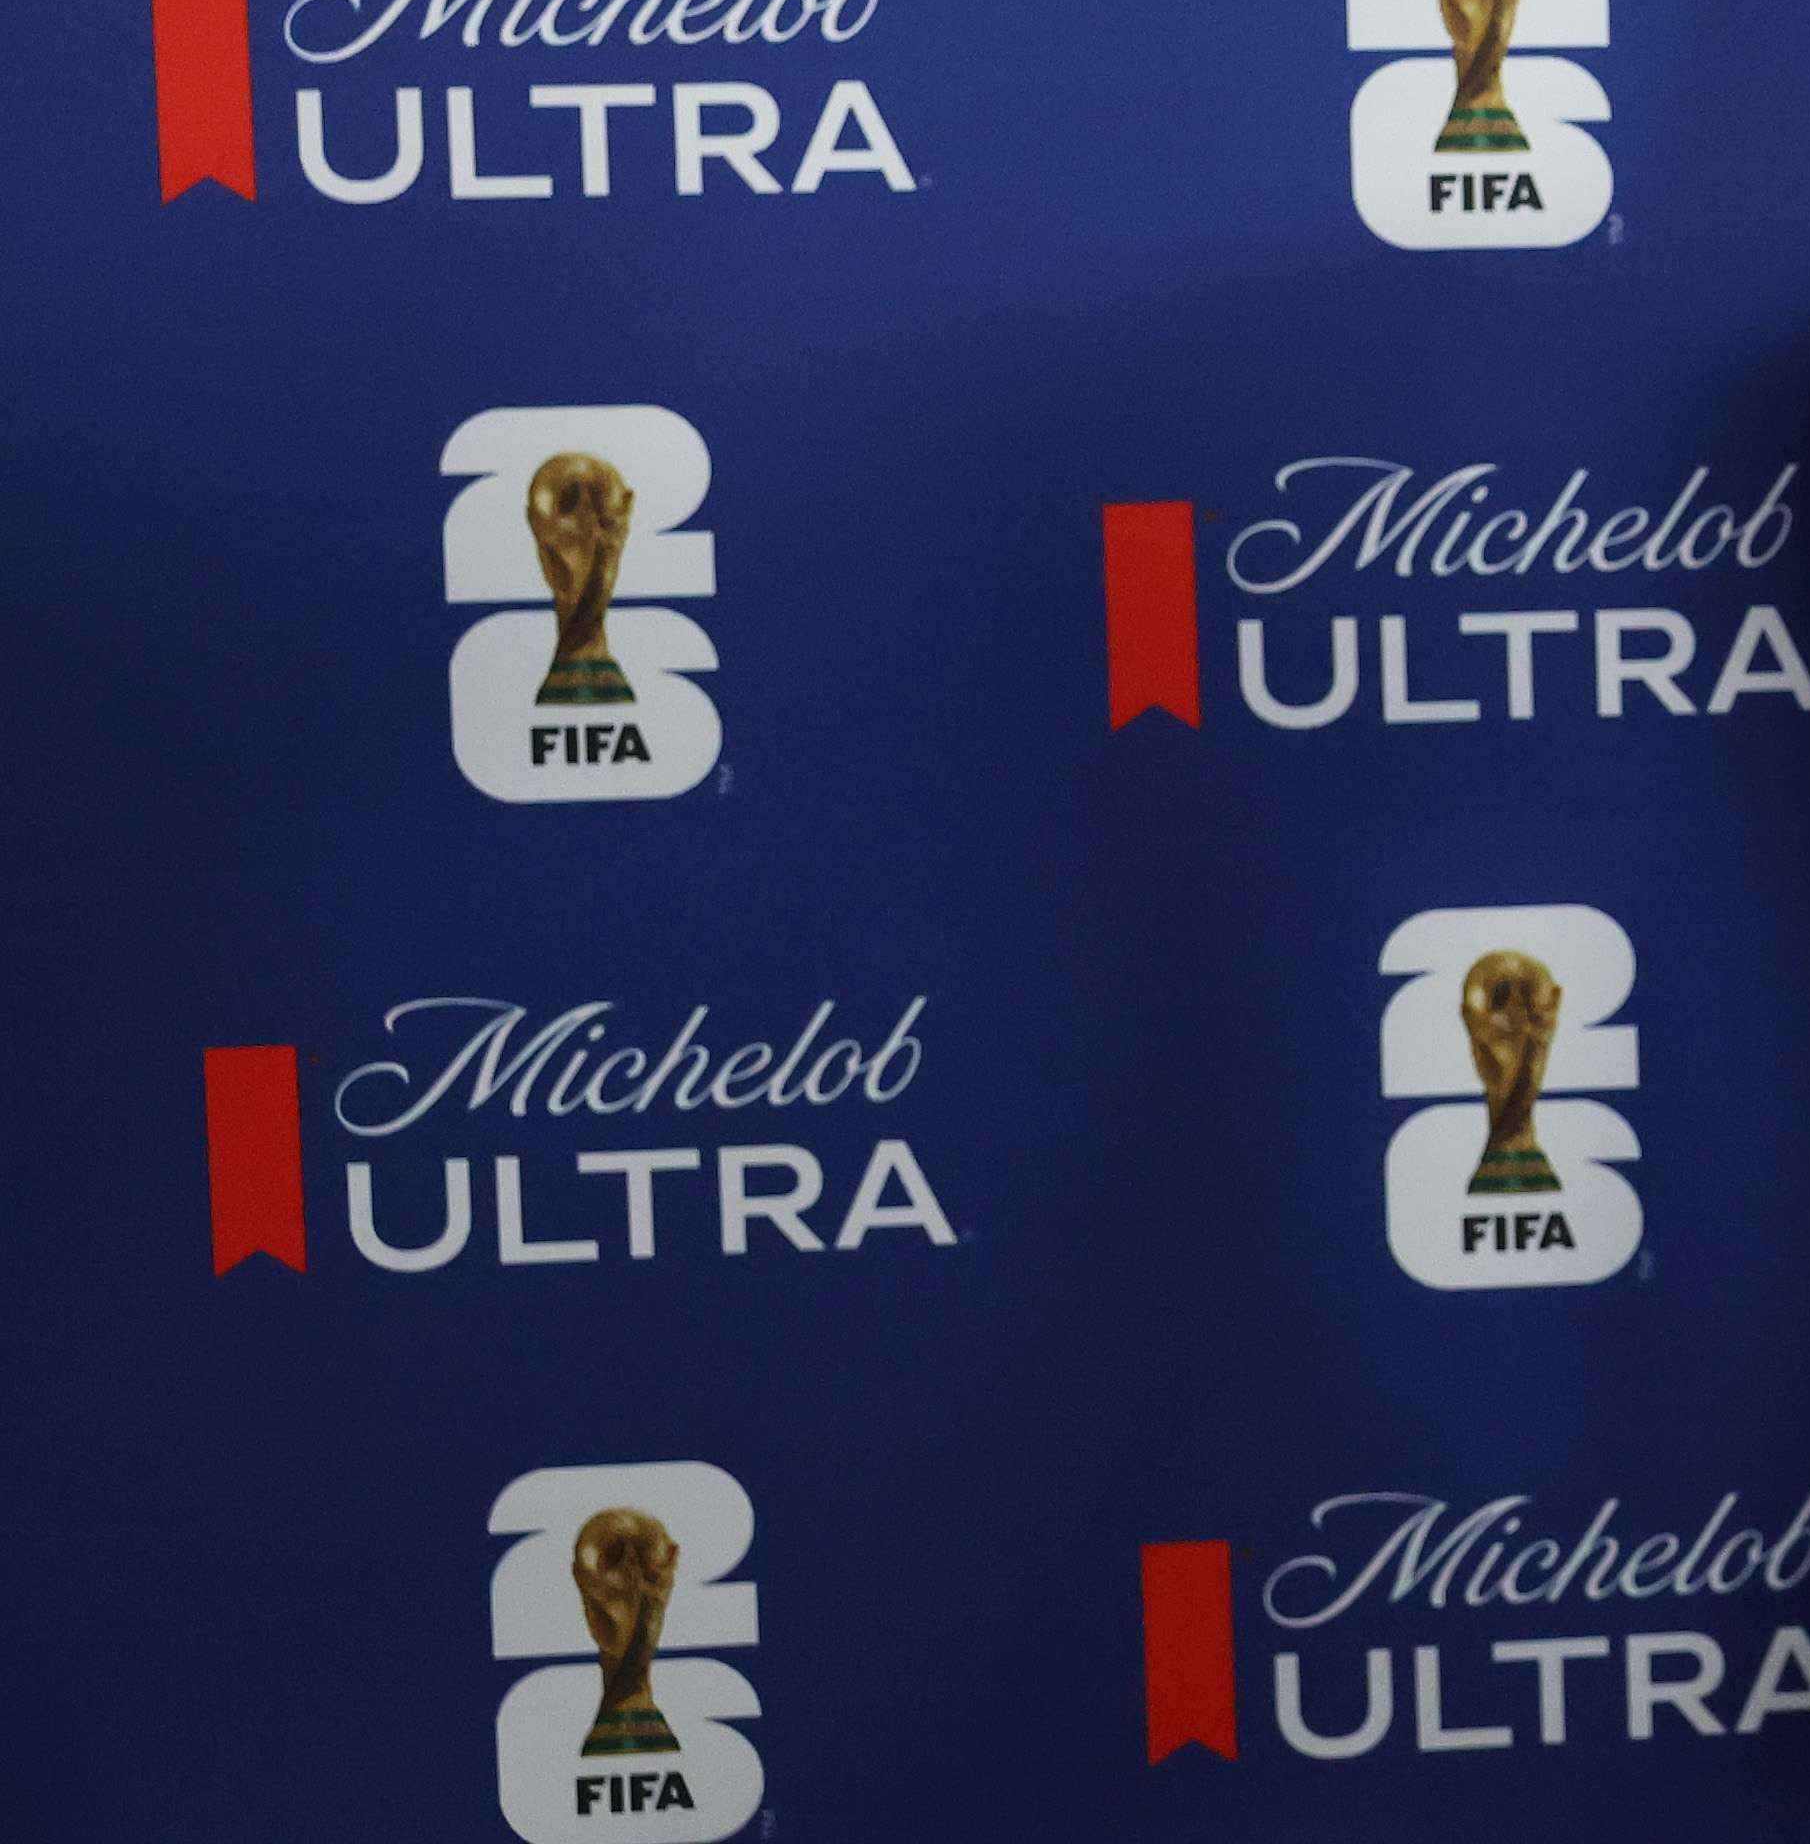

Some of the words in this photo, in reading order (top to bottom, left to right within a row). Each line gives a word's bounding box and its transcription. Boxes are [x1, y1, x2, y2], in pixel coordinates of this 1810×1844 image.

[297, 81, 915, 203] ULTRA
[1430, 174, 1543, 212] FIFA
[1228, 458, 1794, 593] Michelob
[531, 724, 650, 765] FIFA
[336, 997, 925, 1135] Michelob
[347, 1140, 956, 1271] ULTRA
[1463, 1213, 1575, 1253] FIFA
[576, 1772, 694, 1815] FIFA
